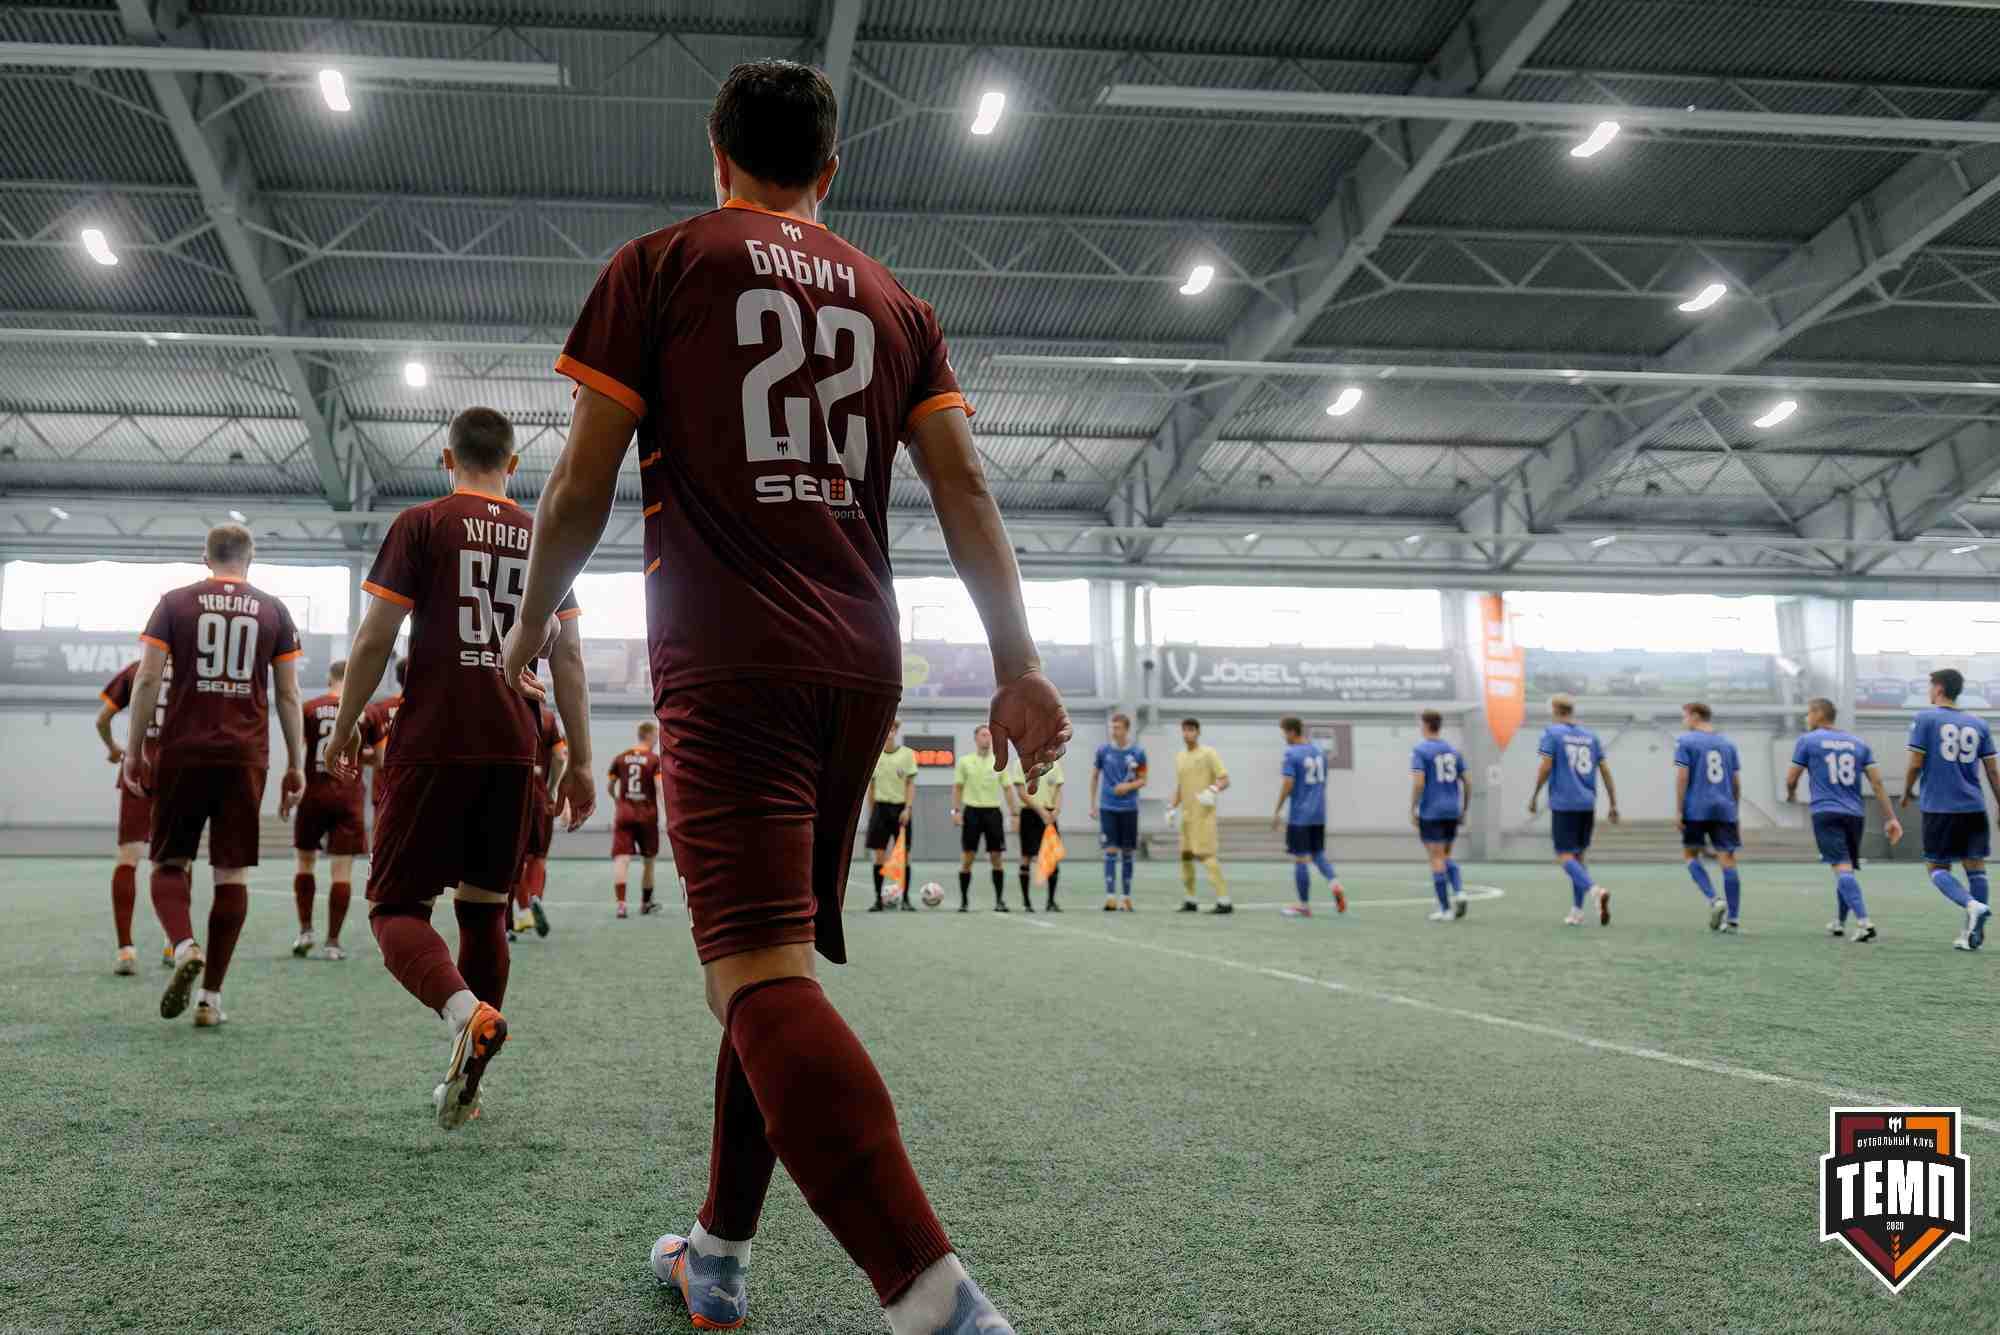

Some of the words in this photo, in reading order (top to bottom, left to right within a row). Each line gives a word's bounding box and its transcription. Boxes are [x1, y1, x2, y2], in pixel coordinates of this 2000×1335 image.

[744, 239, 856, 298] БАБИЧ
[736, 289, 876, 481] 22
[755, 474, 861, 506] SEU
[462, 517, 529, 550] ХУГАЕВ
[198, 594, 260, 615] ЧЕВЕЛЁВ
[459, 549, 529, 651] 55
[196, 613, 259, 680] 90
[196, 680, 252, 694] SEUS
[1563, 743, 1594, 775] 78
[1940, 723, 1979, 764] 89
[628, 764, 641, 792] 2
[1303, 754, 1326, 785] 21
[1434, 752, 1457, 784] 13
[1706, 750, 1724, 784] 8
[1824, 751, 1856, 786] 18
